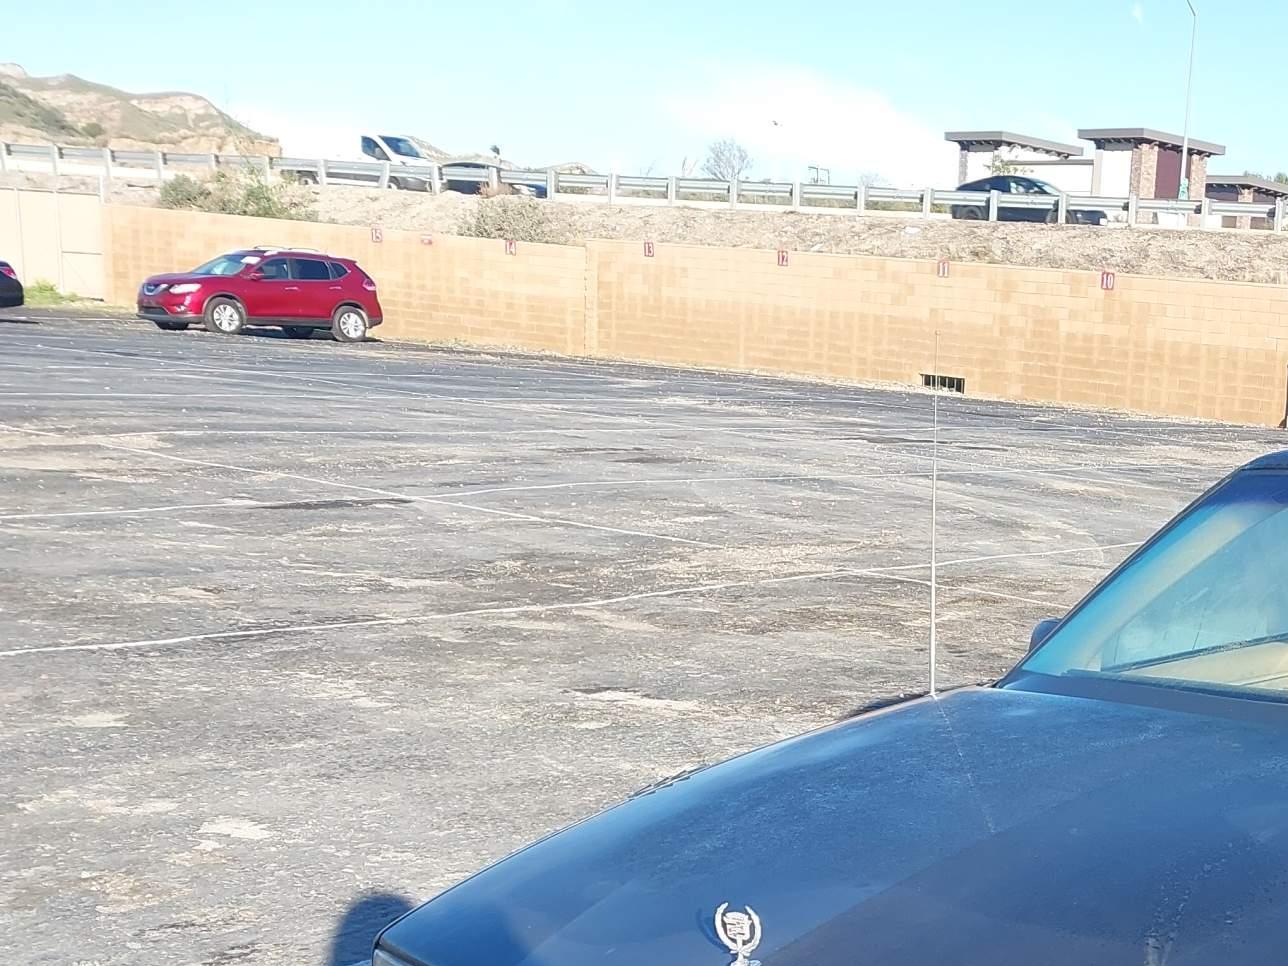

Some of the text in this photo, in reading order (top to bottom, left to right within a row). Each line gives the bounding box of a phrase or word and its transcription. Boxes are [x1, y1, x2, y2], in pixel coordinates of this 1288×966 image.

[371, 227, 383, 243] 15
[937, 261, 949, 278] 11
[1101, 272, 1115, 290] 10
